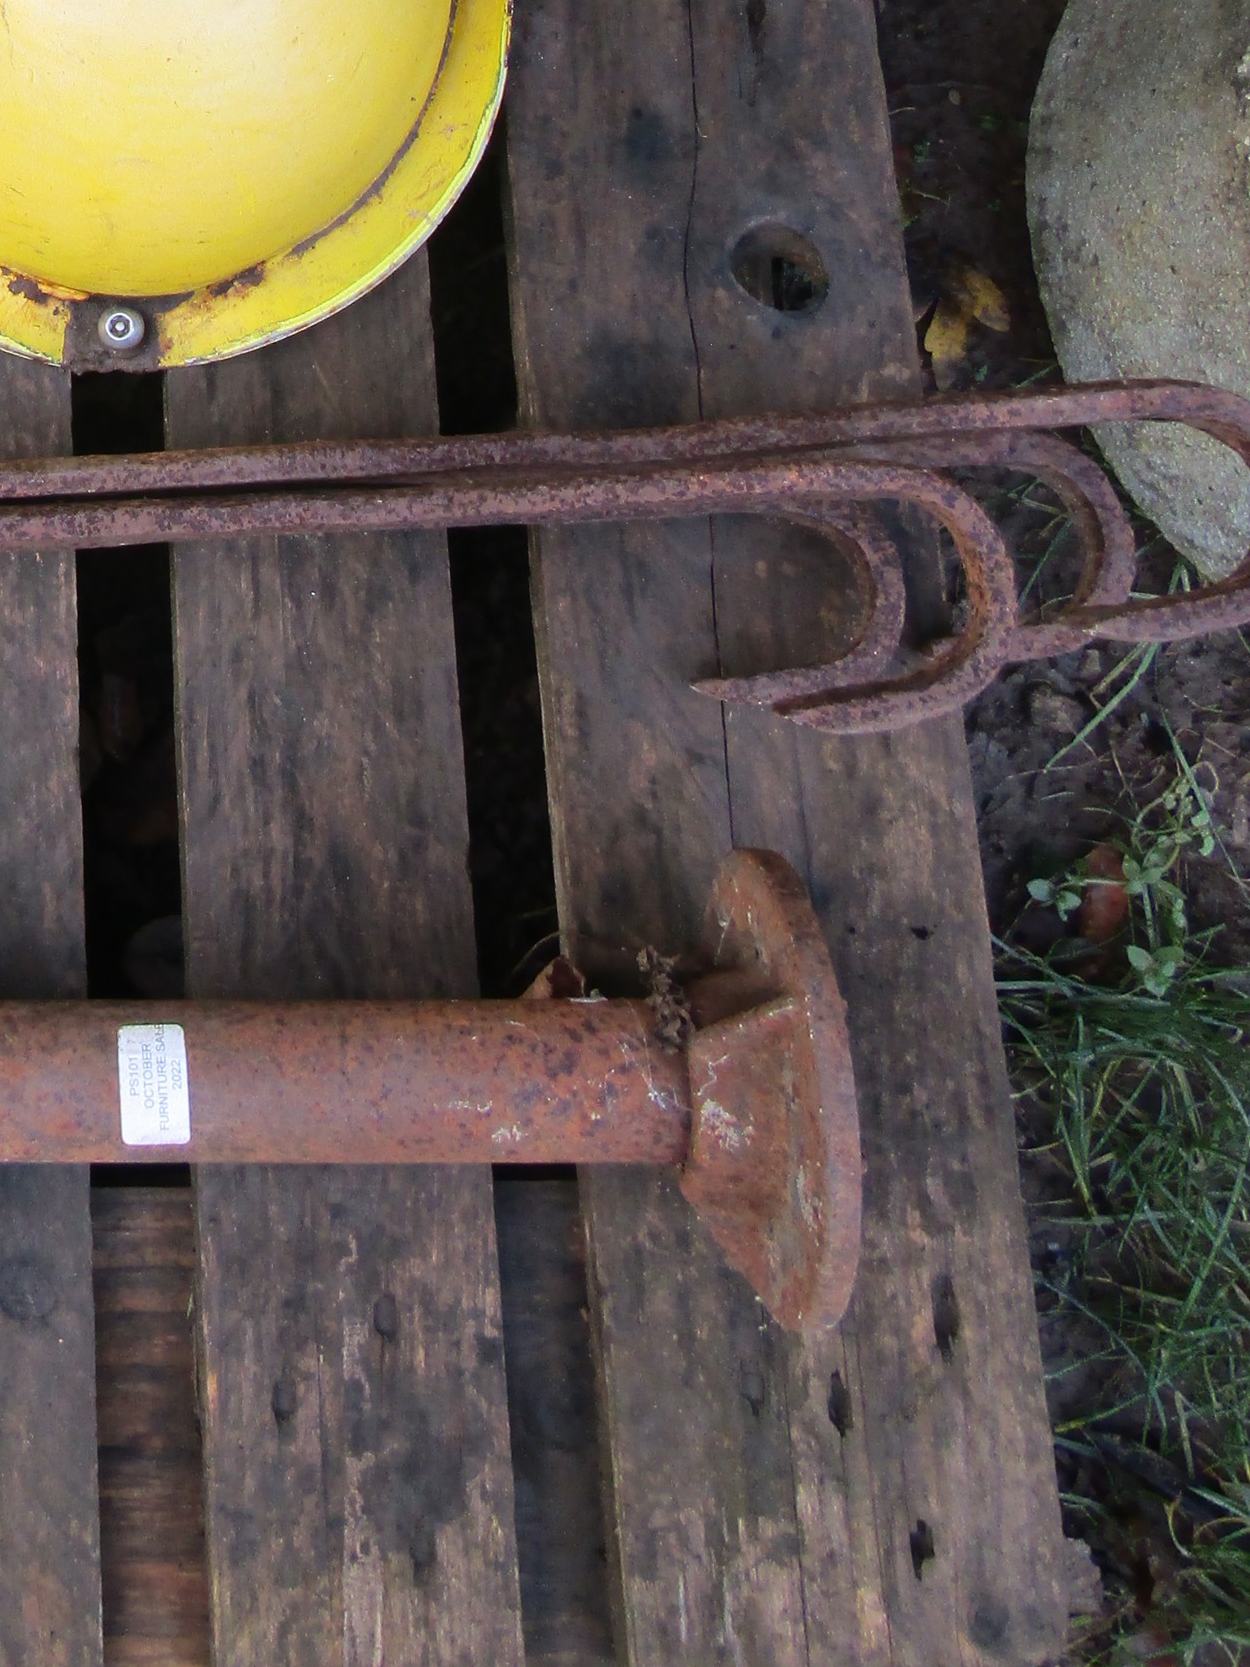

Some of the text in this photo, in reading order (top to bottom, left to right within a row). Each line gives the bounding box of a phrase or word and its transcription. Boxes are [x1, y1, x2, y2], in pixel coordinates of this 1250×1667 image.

[142, 1043, 155, 1109] OCTOBER
[156, 1055, 170, 1131] FURNITURE
[170, 1059, 182, 1090] 2022
